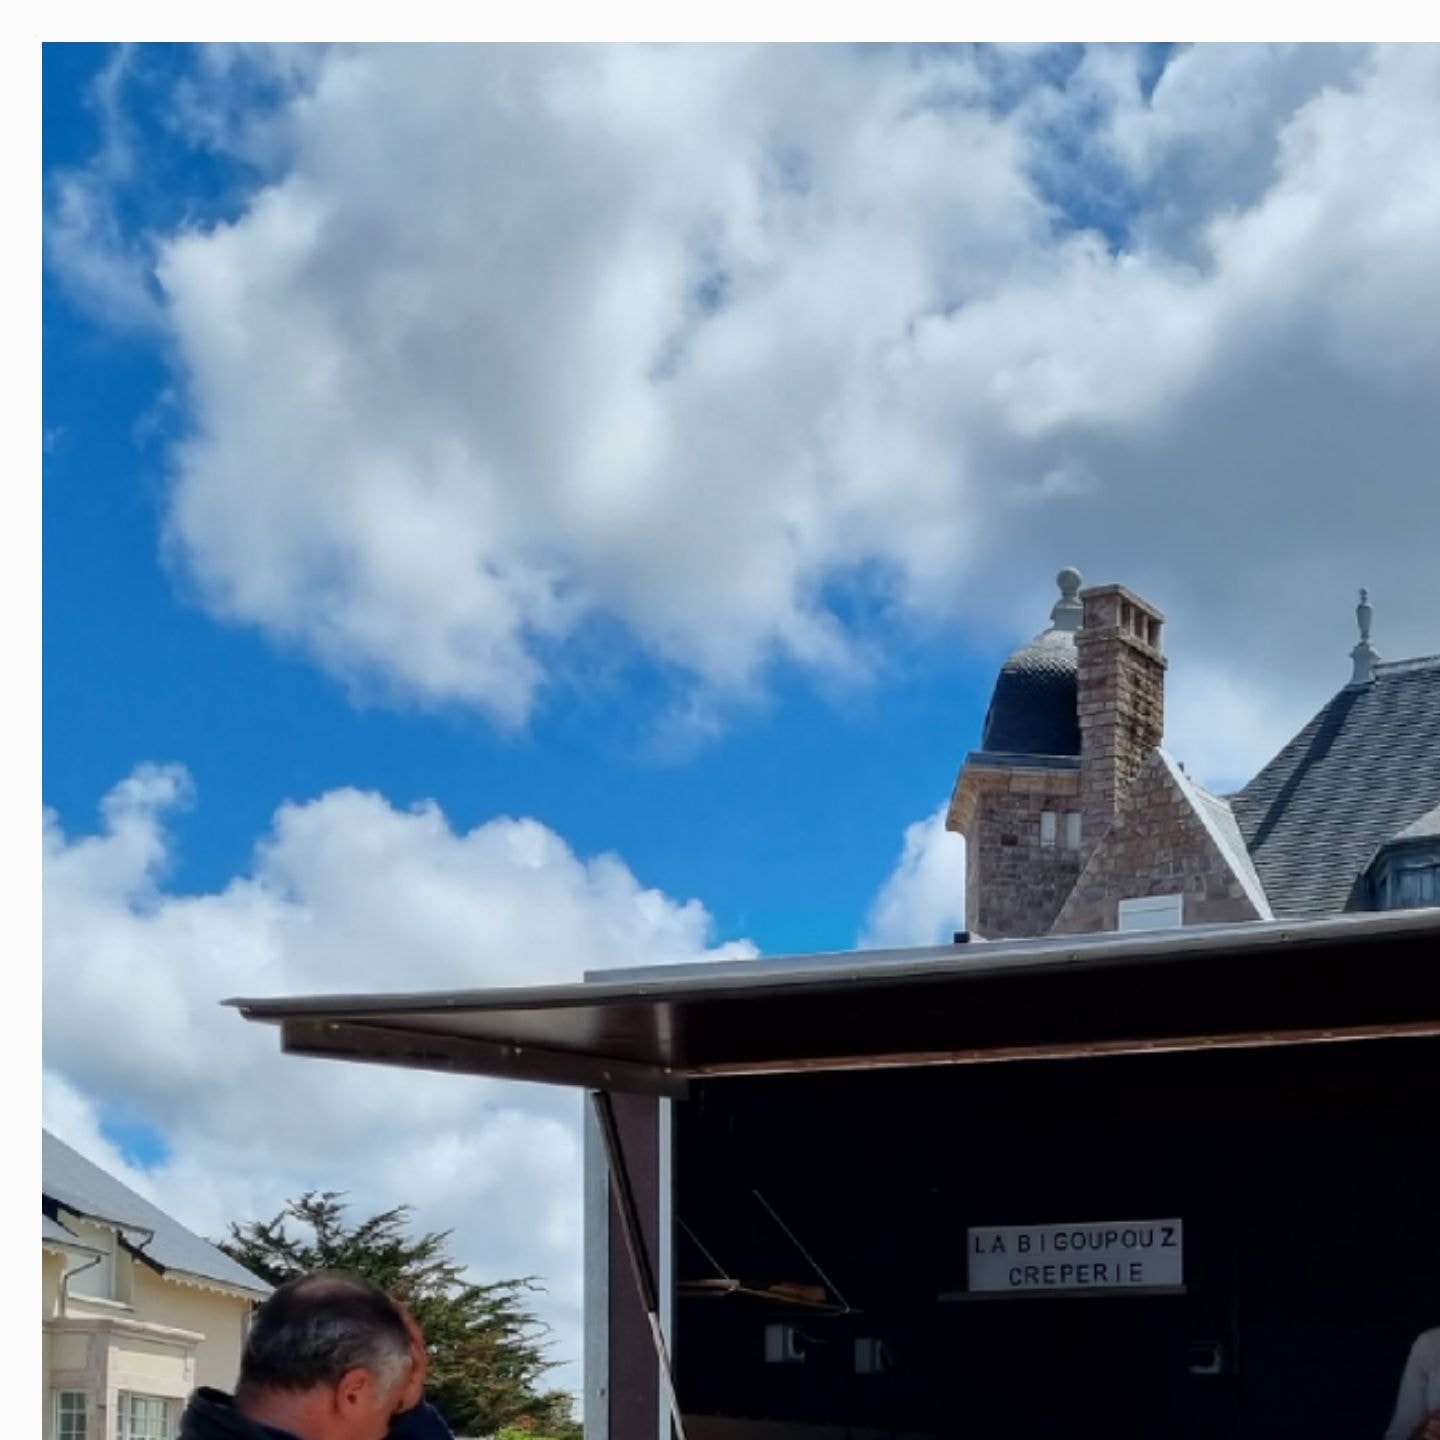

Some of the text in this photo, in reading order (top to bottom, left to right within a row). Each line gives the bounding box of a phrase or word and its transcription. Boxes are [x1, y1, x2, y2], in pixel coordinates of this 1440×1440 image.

[975, 1227, 1177, 1255] LA BIGOUPOUZ
[1009, 1263, 1144, 1287] CREPERIE
